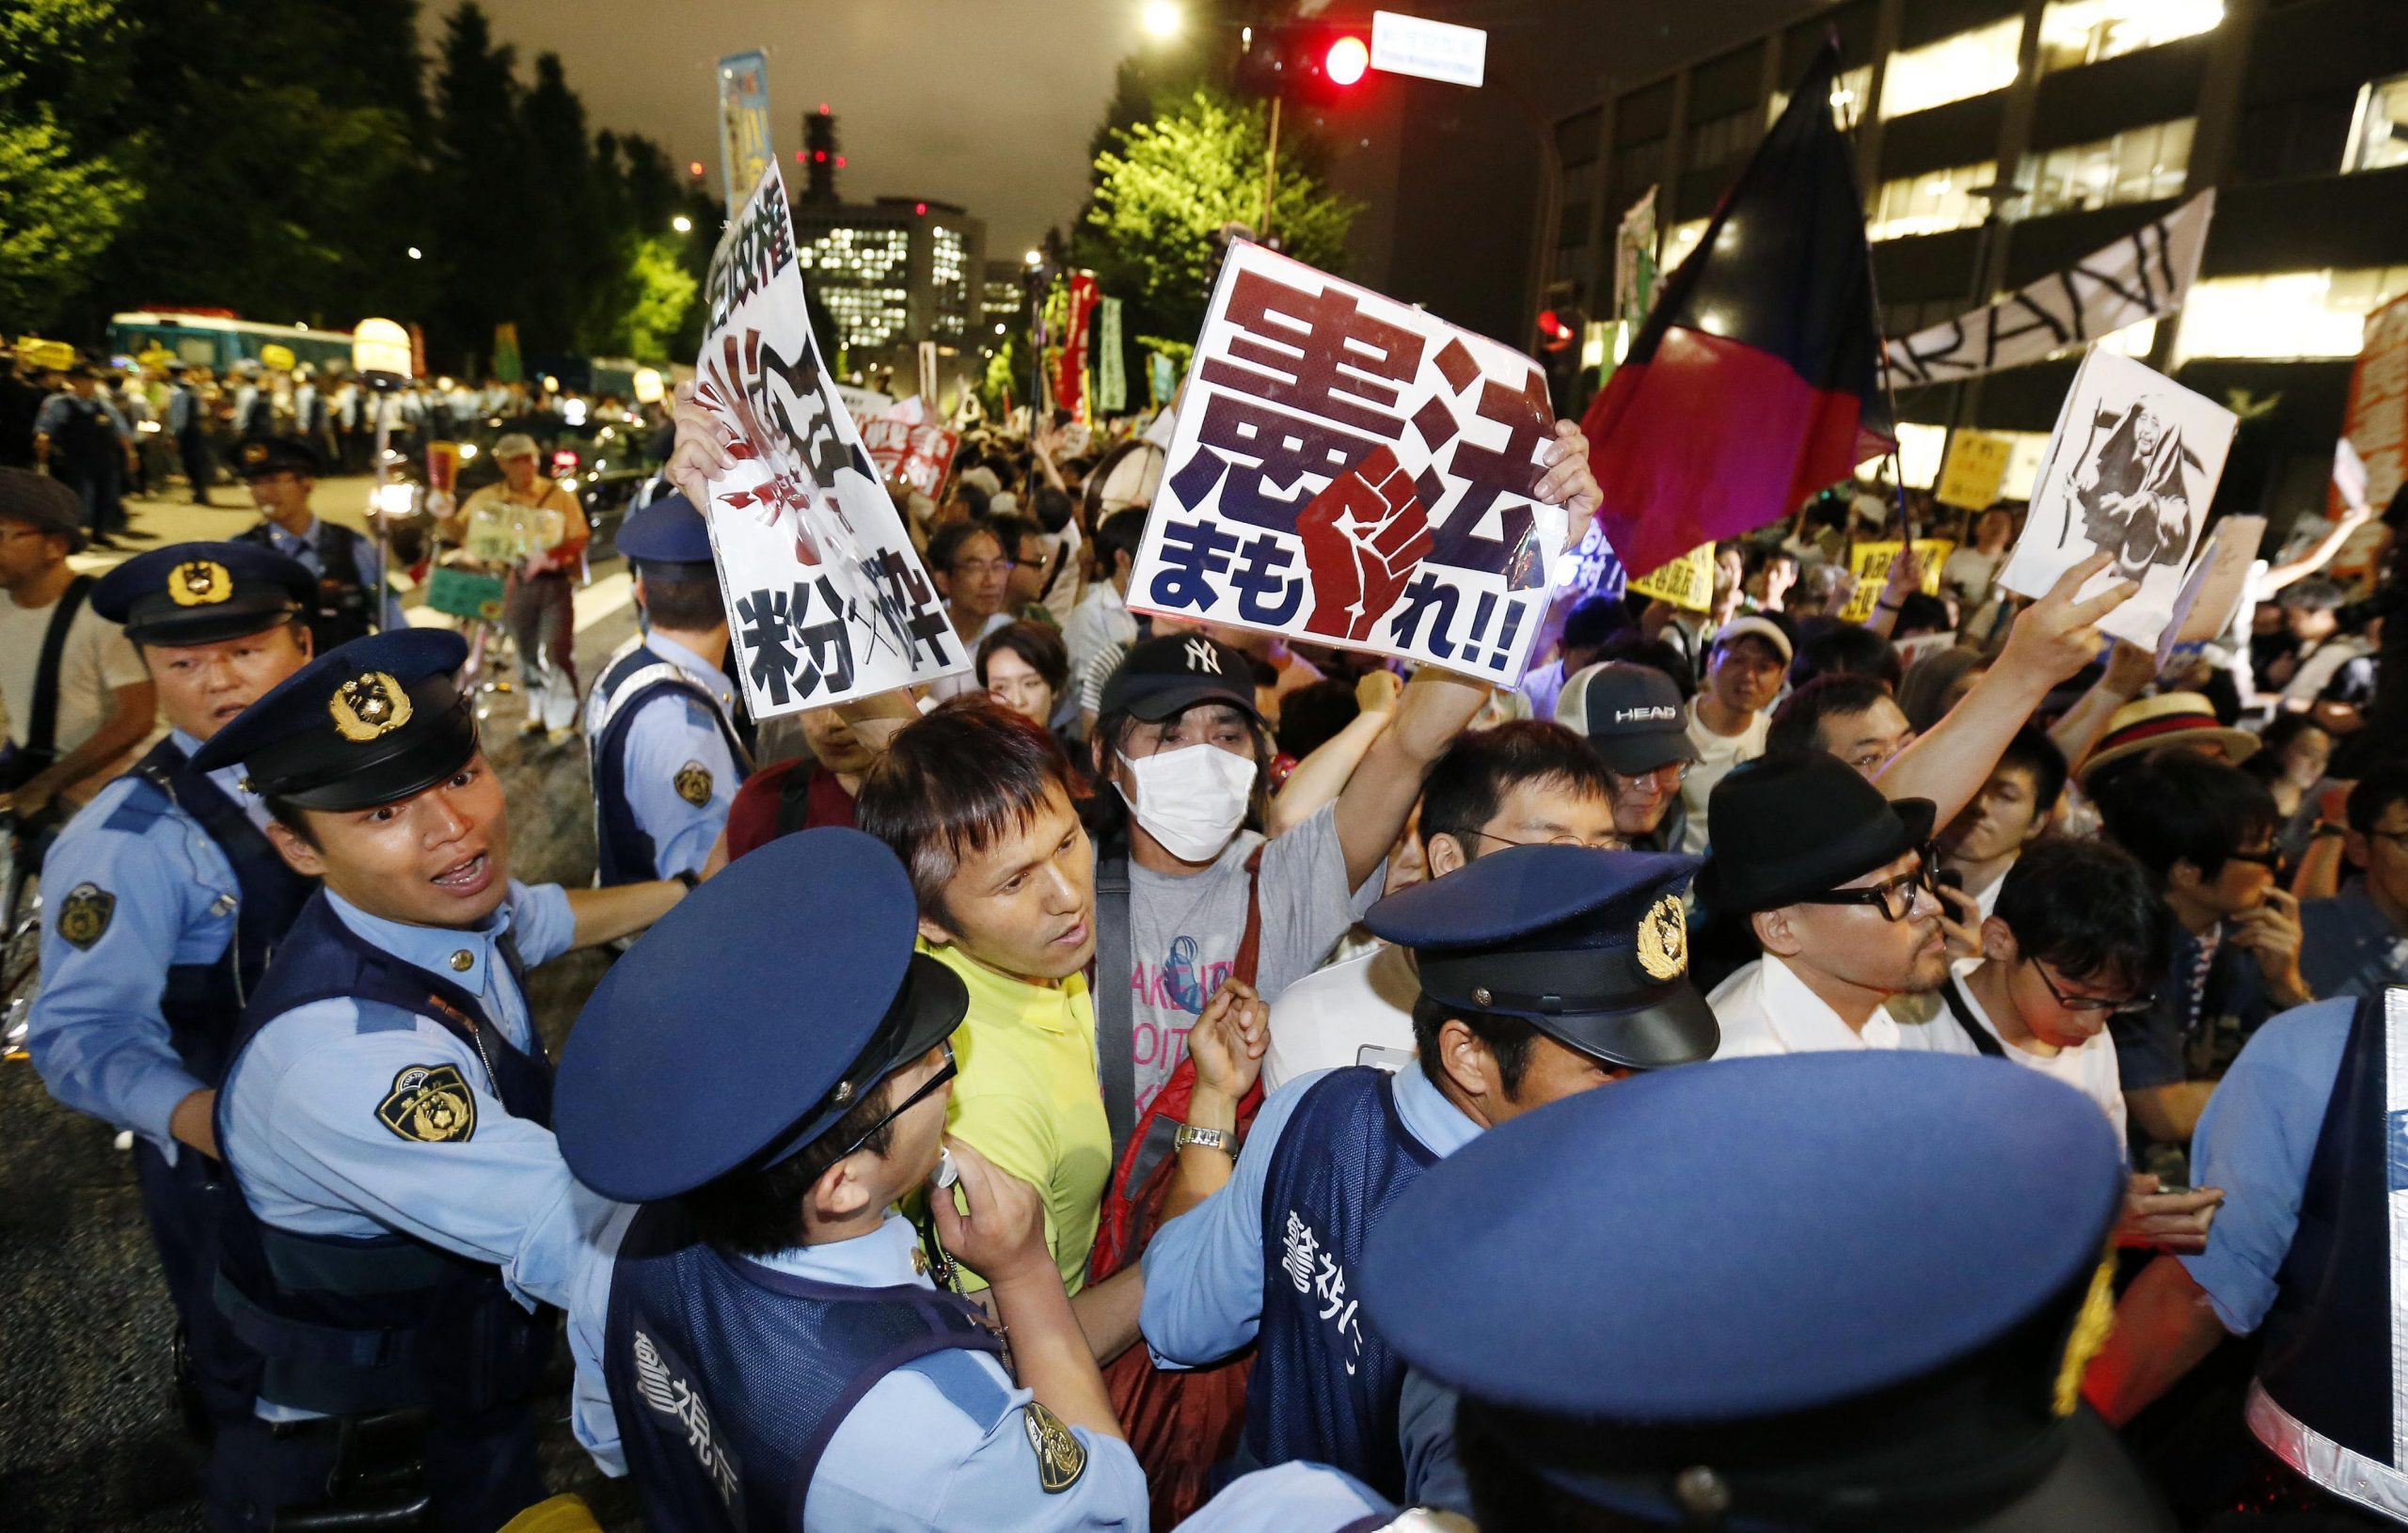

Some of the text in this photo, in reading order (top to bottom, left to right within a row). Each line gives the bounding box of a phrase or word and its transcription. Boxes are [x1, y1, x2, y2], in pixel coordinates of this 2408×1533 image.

[1169, 268, 1555, 592] 憲法
[736, 546, 950, 705] 粉砕
[1183, 637, 1223, 675] NY
[1615, 705, 1676, 723] HEAD
[634, 1330, 738, 1506] 警視庁
